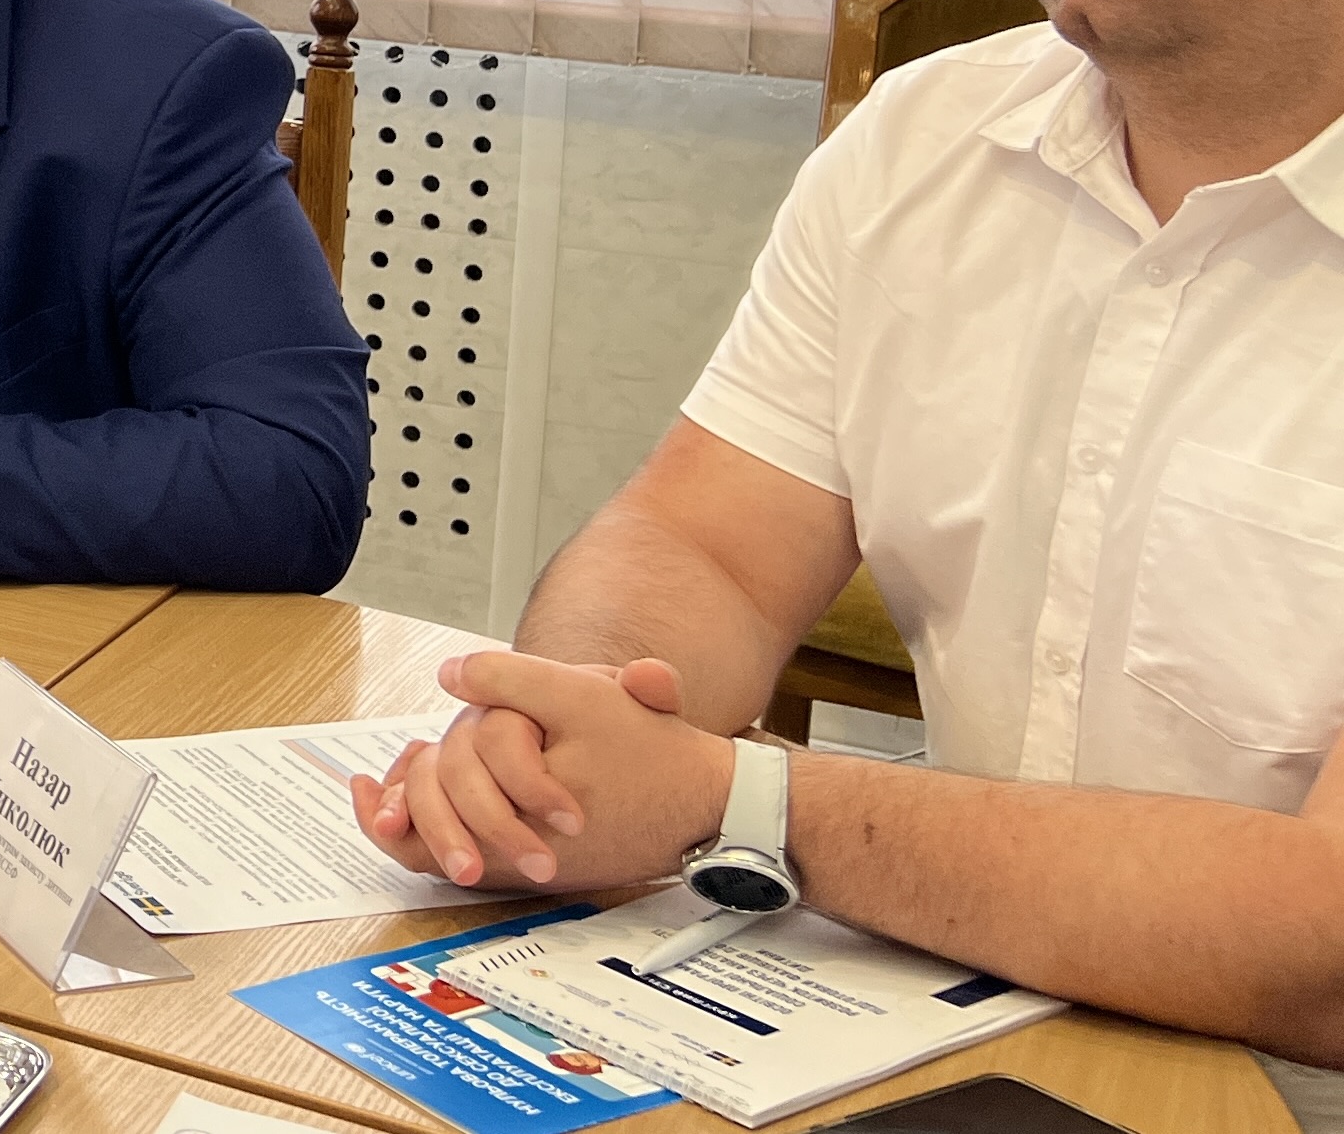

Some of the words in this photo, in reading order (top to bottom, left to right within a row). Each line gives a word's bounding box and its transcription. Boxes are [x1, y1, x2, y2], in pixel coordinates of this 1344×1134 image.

[10, 737, 71, 811] Назар
[684, 955, 728, 974] РОБО
[735, 952, 803, 981] ФАХІВЦІВ
[754, 947, 814, 973] ДИТИНИ
[721, 971, 808, 1008] СОЦІАЛЬНОЇ
[743, 968, 790, 988] ЧЕРЕЗ
[352, 980, 424, 1020] НАРУГИ
[736, 990, 794, 1015] ОСВІТНІ
[787, 985, 861, 1018] РОЗВИТОК
[799, 978, 889, 1017] ПІДГОТОВКИ
[316, 990, 452, 1069] ТОЛЕРАНТНІСТЬ
[364, 1006, 489, 1073] СЕКСУАЛЬНОЇ
[422, 1018, 449, 1034] ТА
[361, 1048, 417, 1080] unicef
[446, 1032, 581, 1104] ЕКСПЛУАТАЦІЇ
[487, 1068, 524, 1088] ДО
[451, 1067, 542, 1116] НУЛЬОВА
